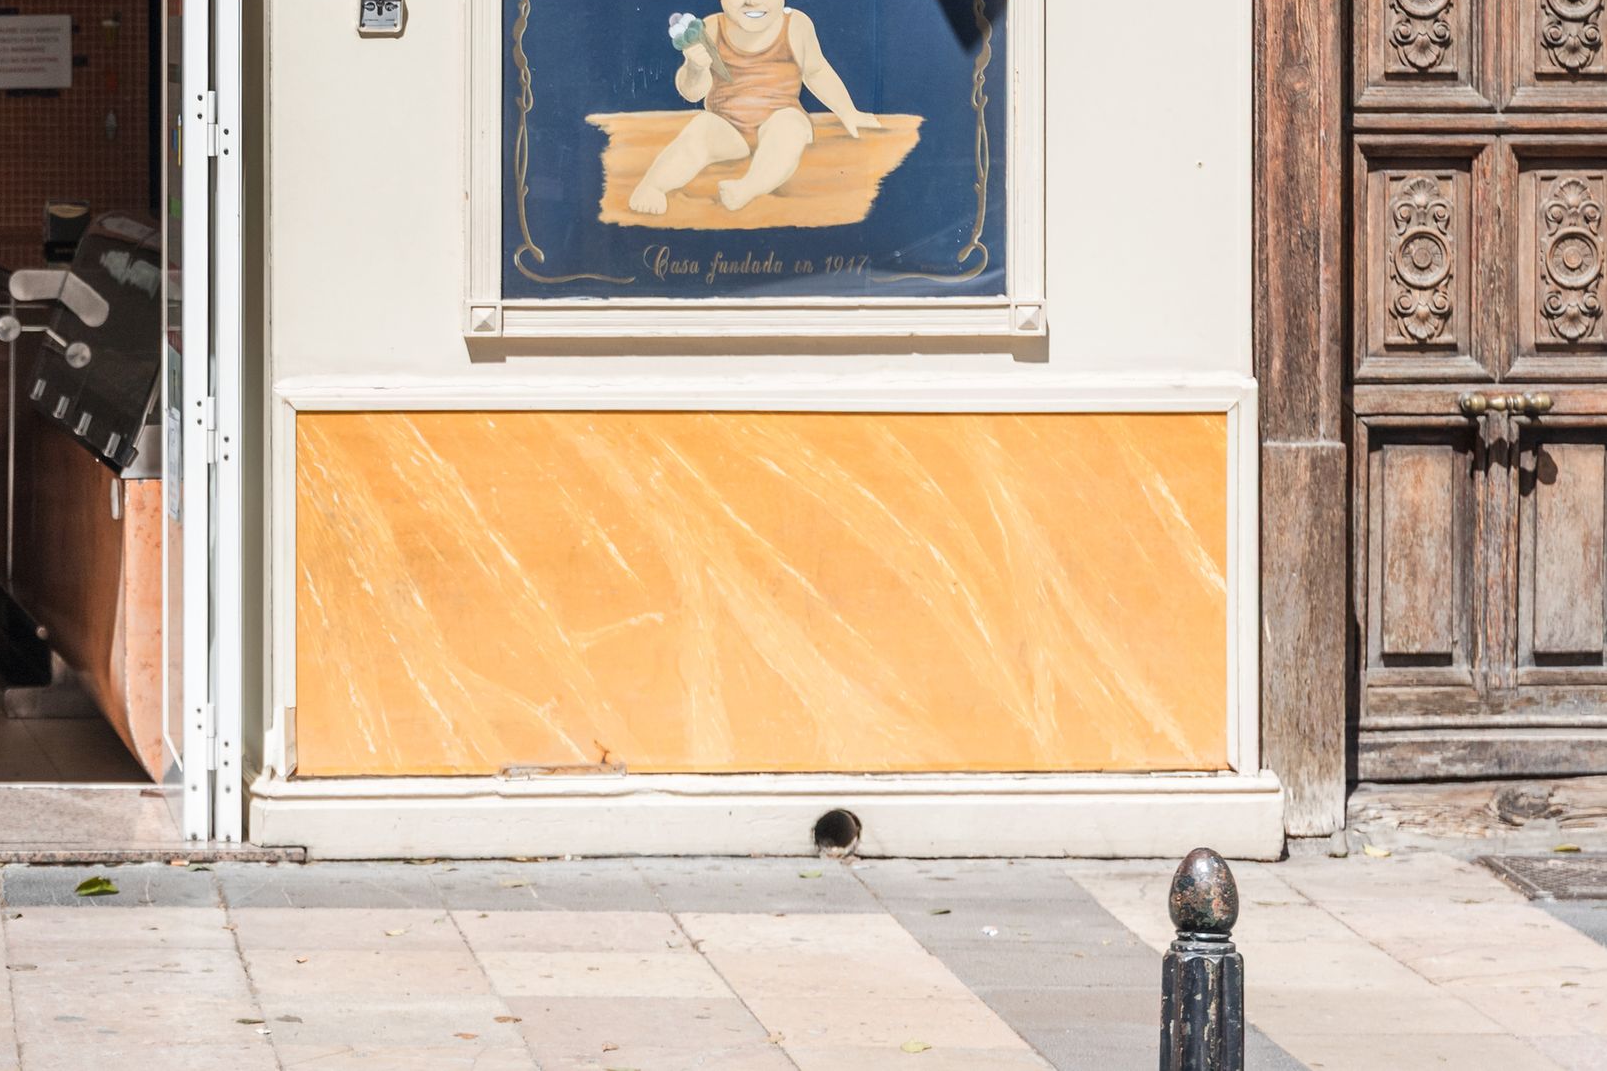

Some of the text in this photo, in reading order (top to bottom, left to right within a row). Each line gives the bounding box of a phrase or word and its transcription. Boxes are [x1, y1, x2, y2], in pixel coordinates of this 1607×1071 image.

[643, 244, 700, 281] Casa
[705, 250, 784, 284] fundada
[794, 259, 814, 274] en
